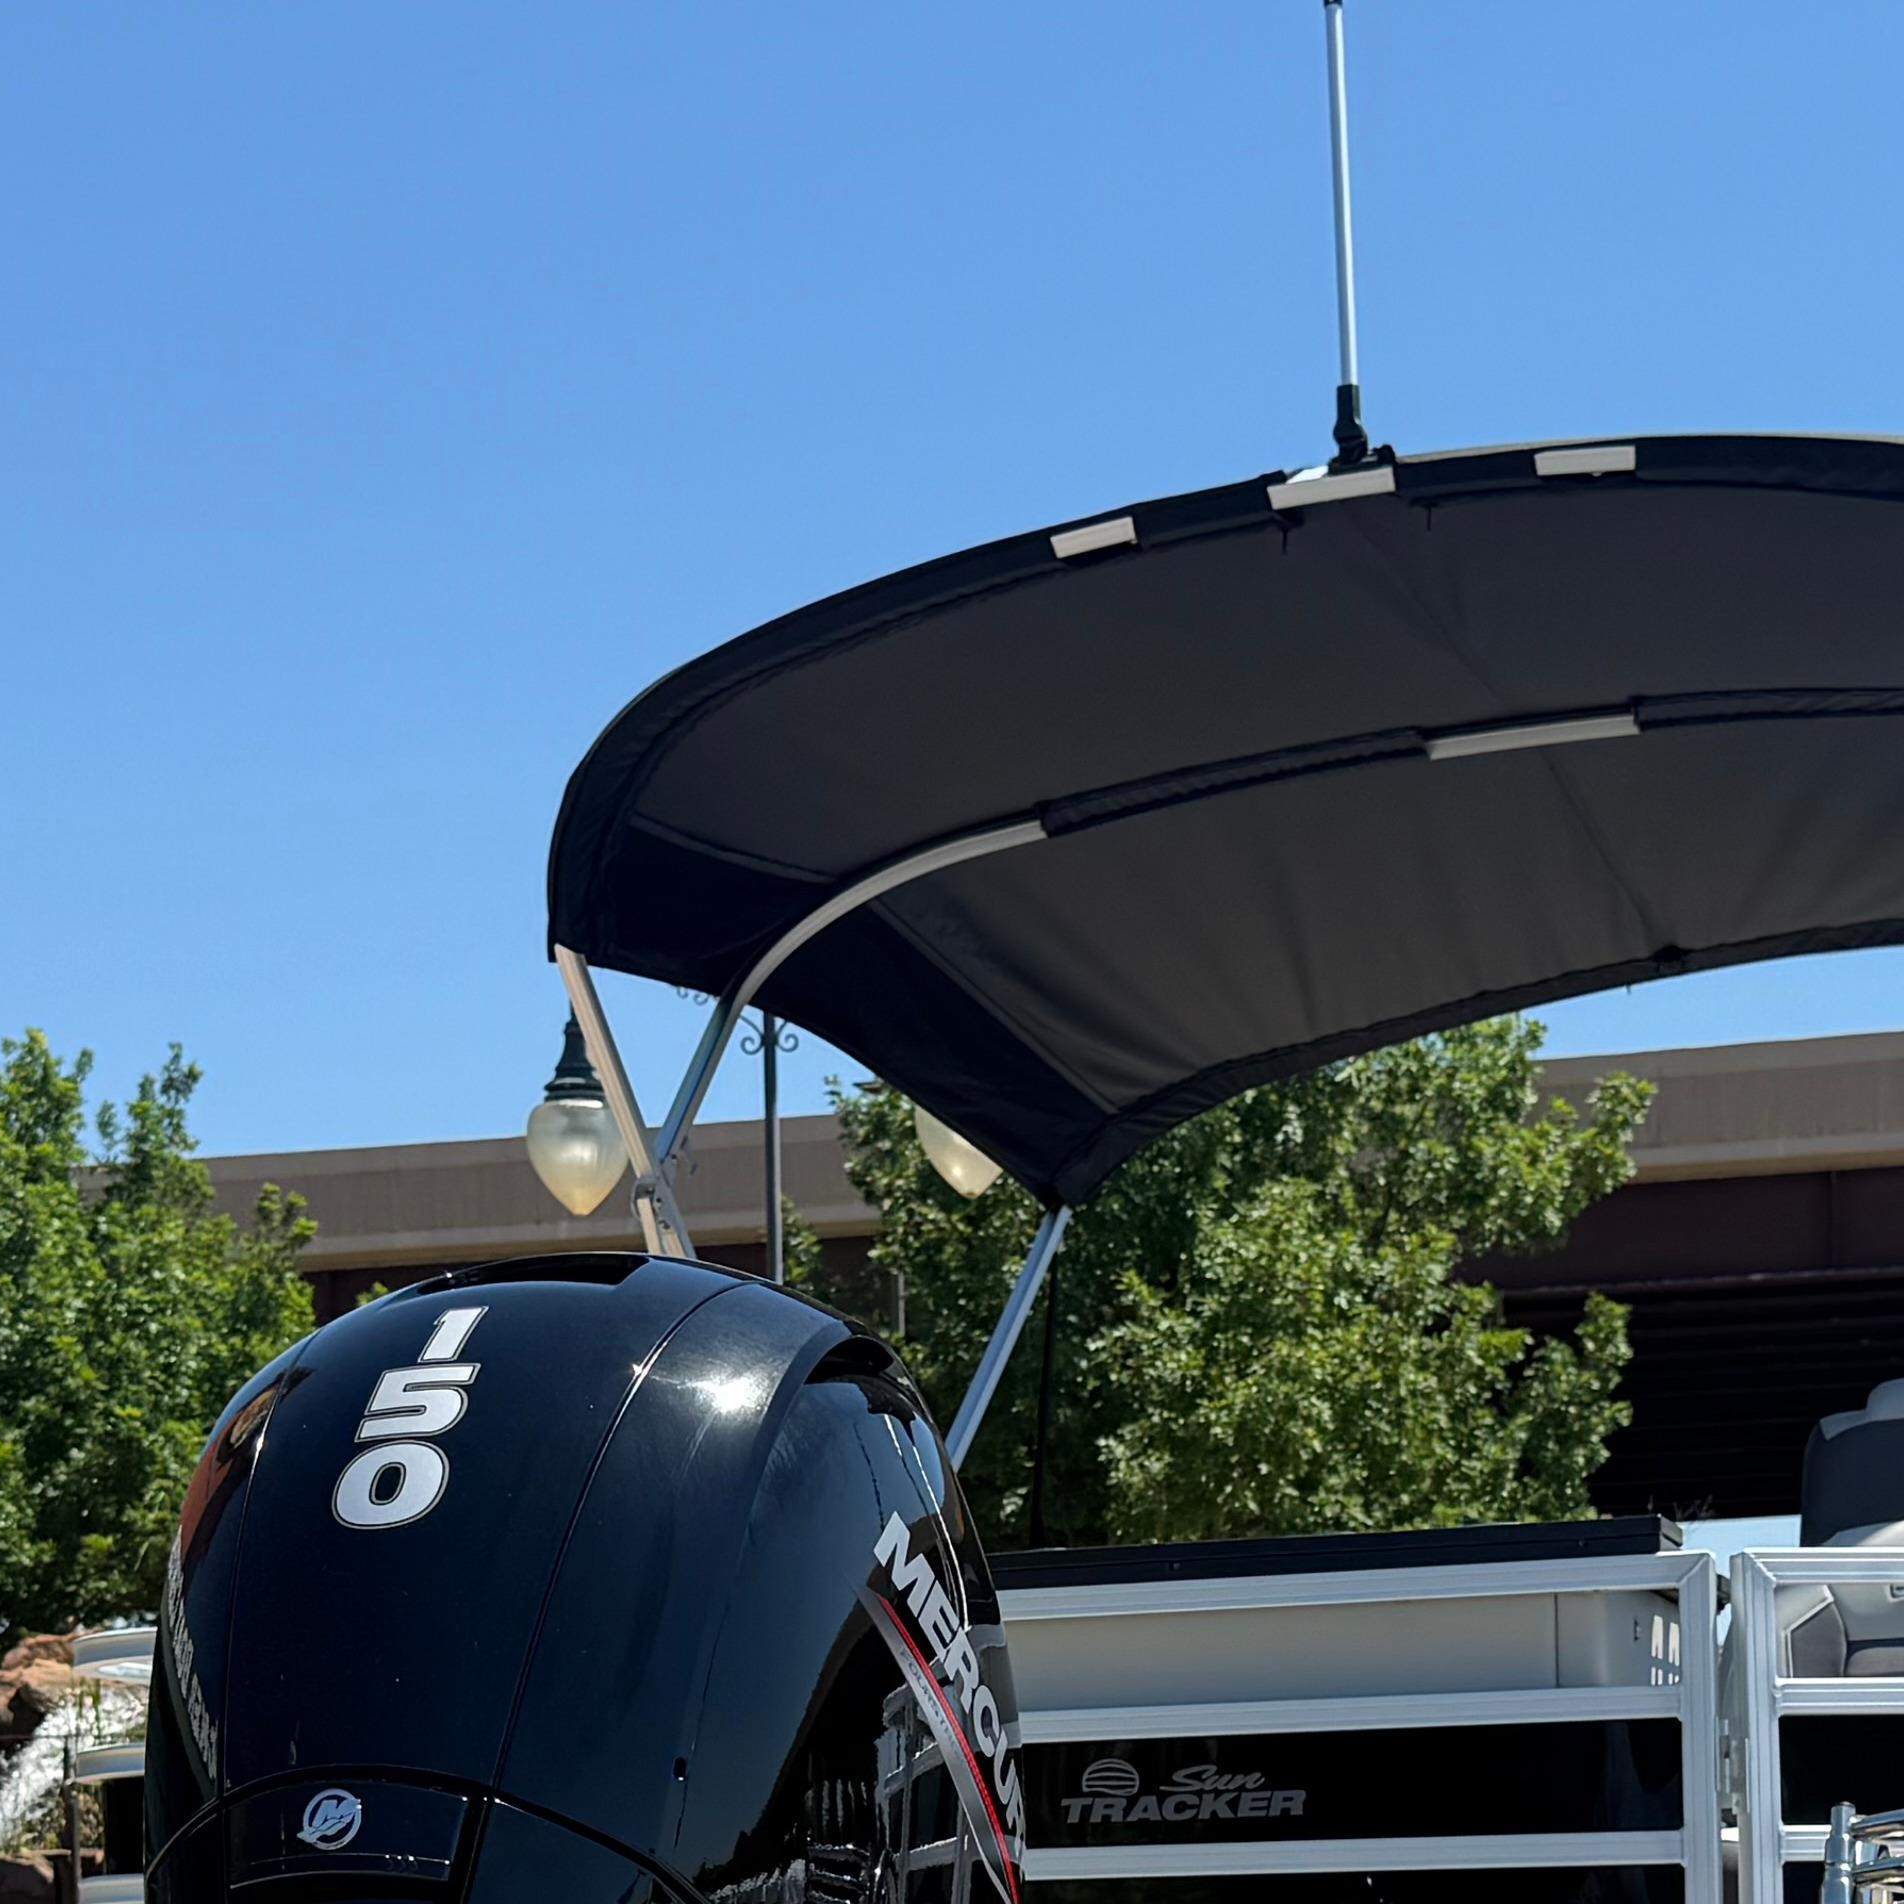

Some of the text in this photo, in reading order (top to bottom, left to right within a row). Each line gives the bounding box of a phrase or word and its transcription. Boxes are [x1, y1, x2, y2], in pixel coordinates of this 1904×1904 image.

[873, 1511, 1026, 1884] MERCUR
[1159, 1764, 1265, 1792] Sun
[1061, 1789, 1306, 1824] TRACKER
